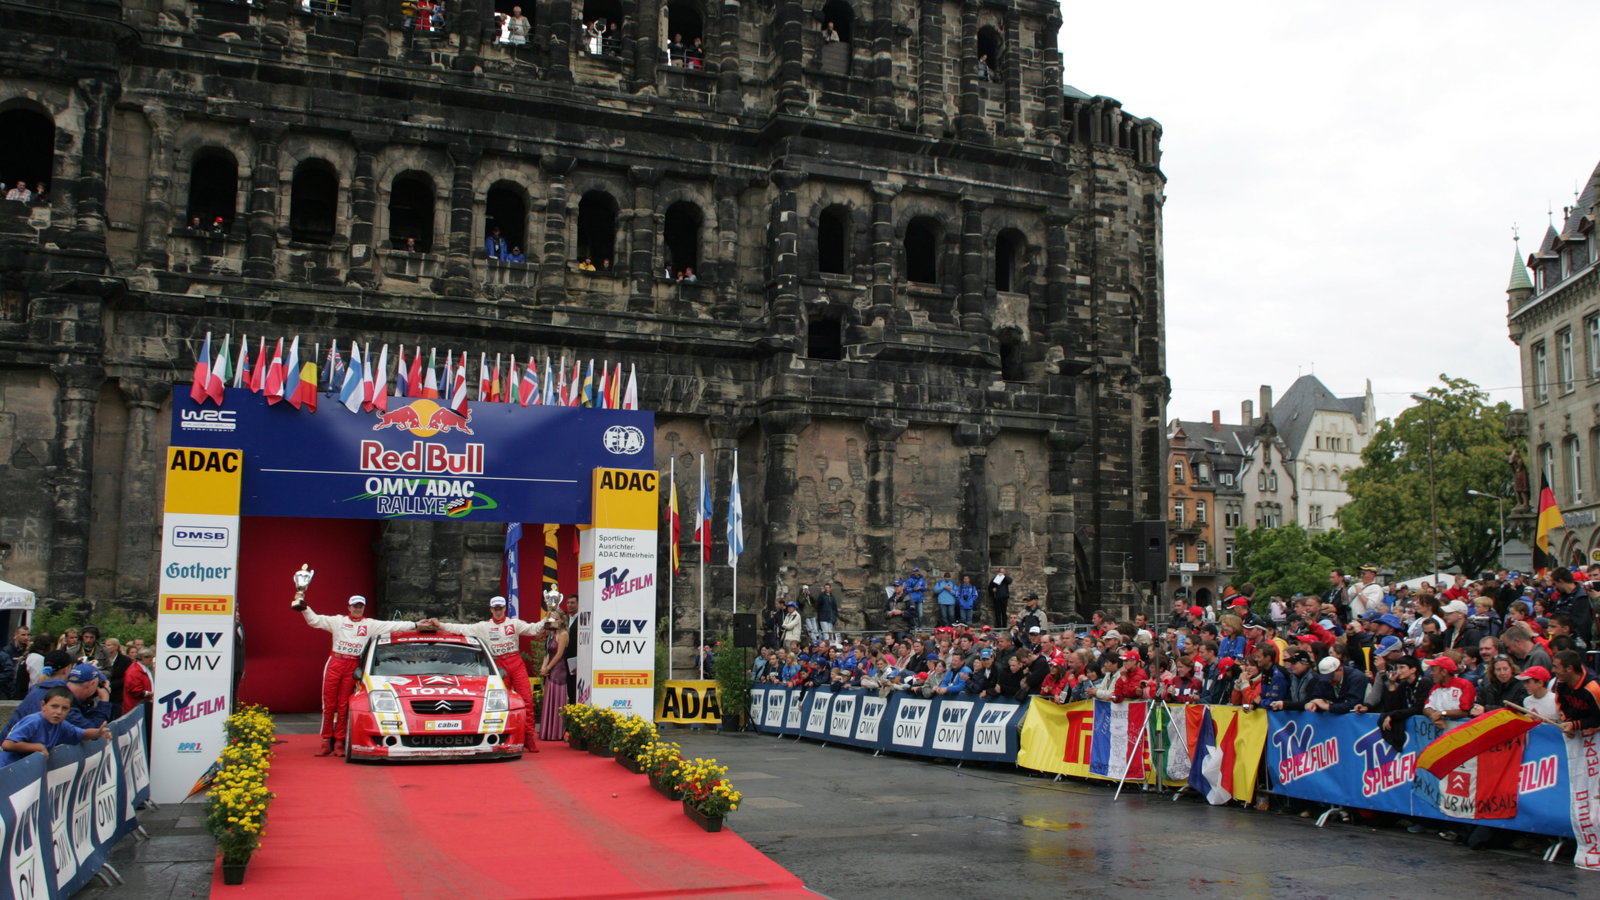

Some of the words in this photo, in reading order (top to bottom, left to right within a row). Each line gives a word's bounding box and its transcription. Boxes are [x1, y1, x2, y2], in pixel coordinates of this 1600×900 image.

[181, 408, 237, 422] WRC
[606, 430, 641, 449] FIA
[171, 450, 239, 473] ADAC
[360, 440, 423, 472] Red
[425, 442, 484, 475] Bull
[365, 477, 419, 496] OMV
[426, 479, 475, 497] ADAC
[600, 471, 656, 492] ADAC
[377, 496, 447, 515] RALLYE
[176, 531, 225, 540] DMSB
[166, 562, 232, 582] Gothaer
[598, 567, 629, 588] TV
[601, 573, 653, 601] SPIELFILM
[166, 597, 227, 611] PIRELLI
[600, 640, 646, 654] OMV
[166, 655, 221, 670] OMV
[598, 673, 648, 685] PIRELLI
[406, 687, 476, 695] TOTAL
[158, 689, 196, 717] TV
[161, 695, 225, 729] SPIELFILM
[662, 687, 721, 719] ADA
[768, 711, 780, 721] OMV
[810, 714, 825, 727] OMV
[832, 717, 849, 730] OMV
[860, 721, 876, 734] OMV
[896, 724, 921, 739] OMV
[938, 728, 963, 743] OMV
[977, 730, 1001, 745] OMV
[1273, 720, 1314, 761] TV
[1279, 737, 1339, 785] SPIELFILM
[1363, 752, 1416, 797] SPIELFI
